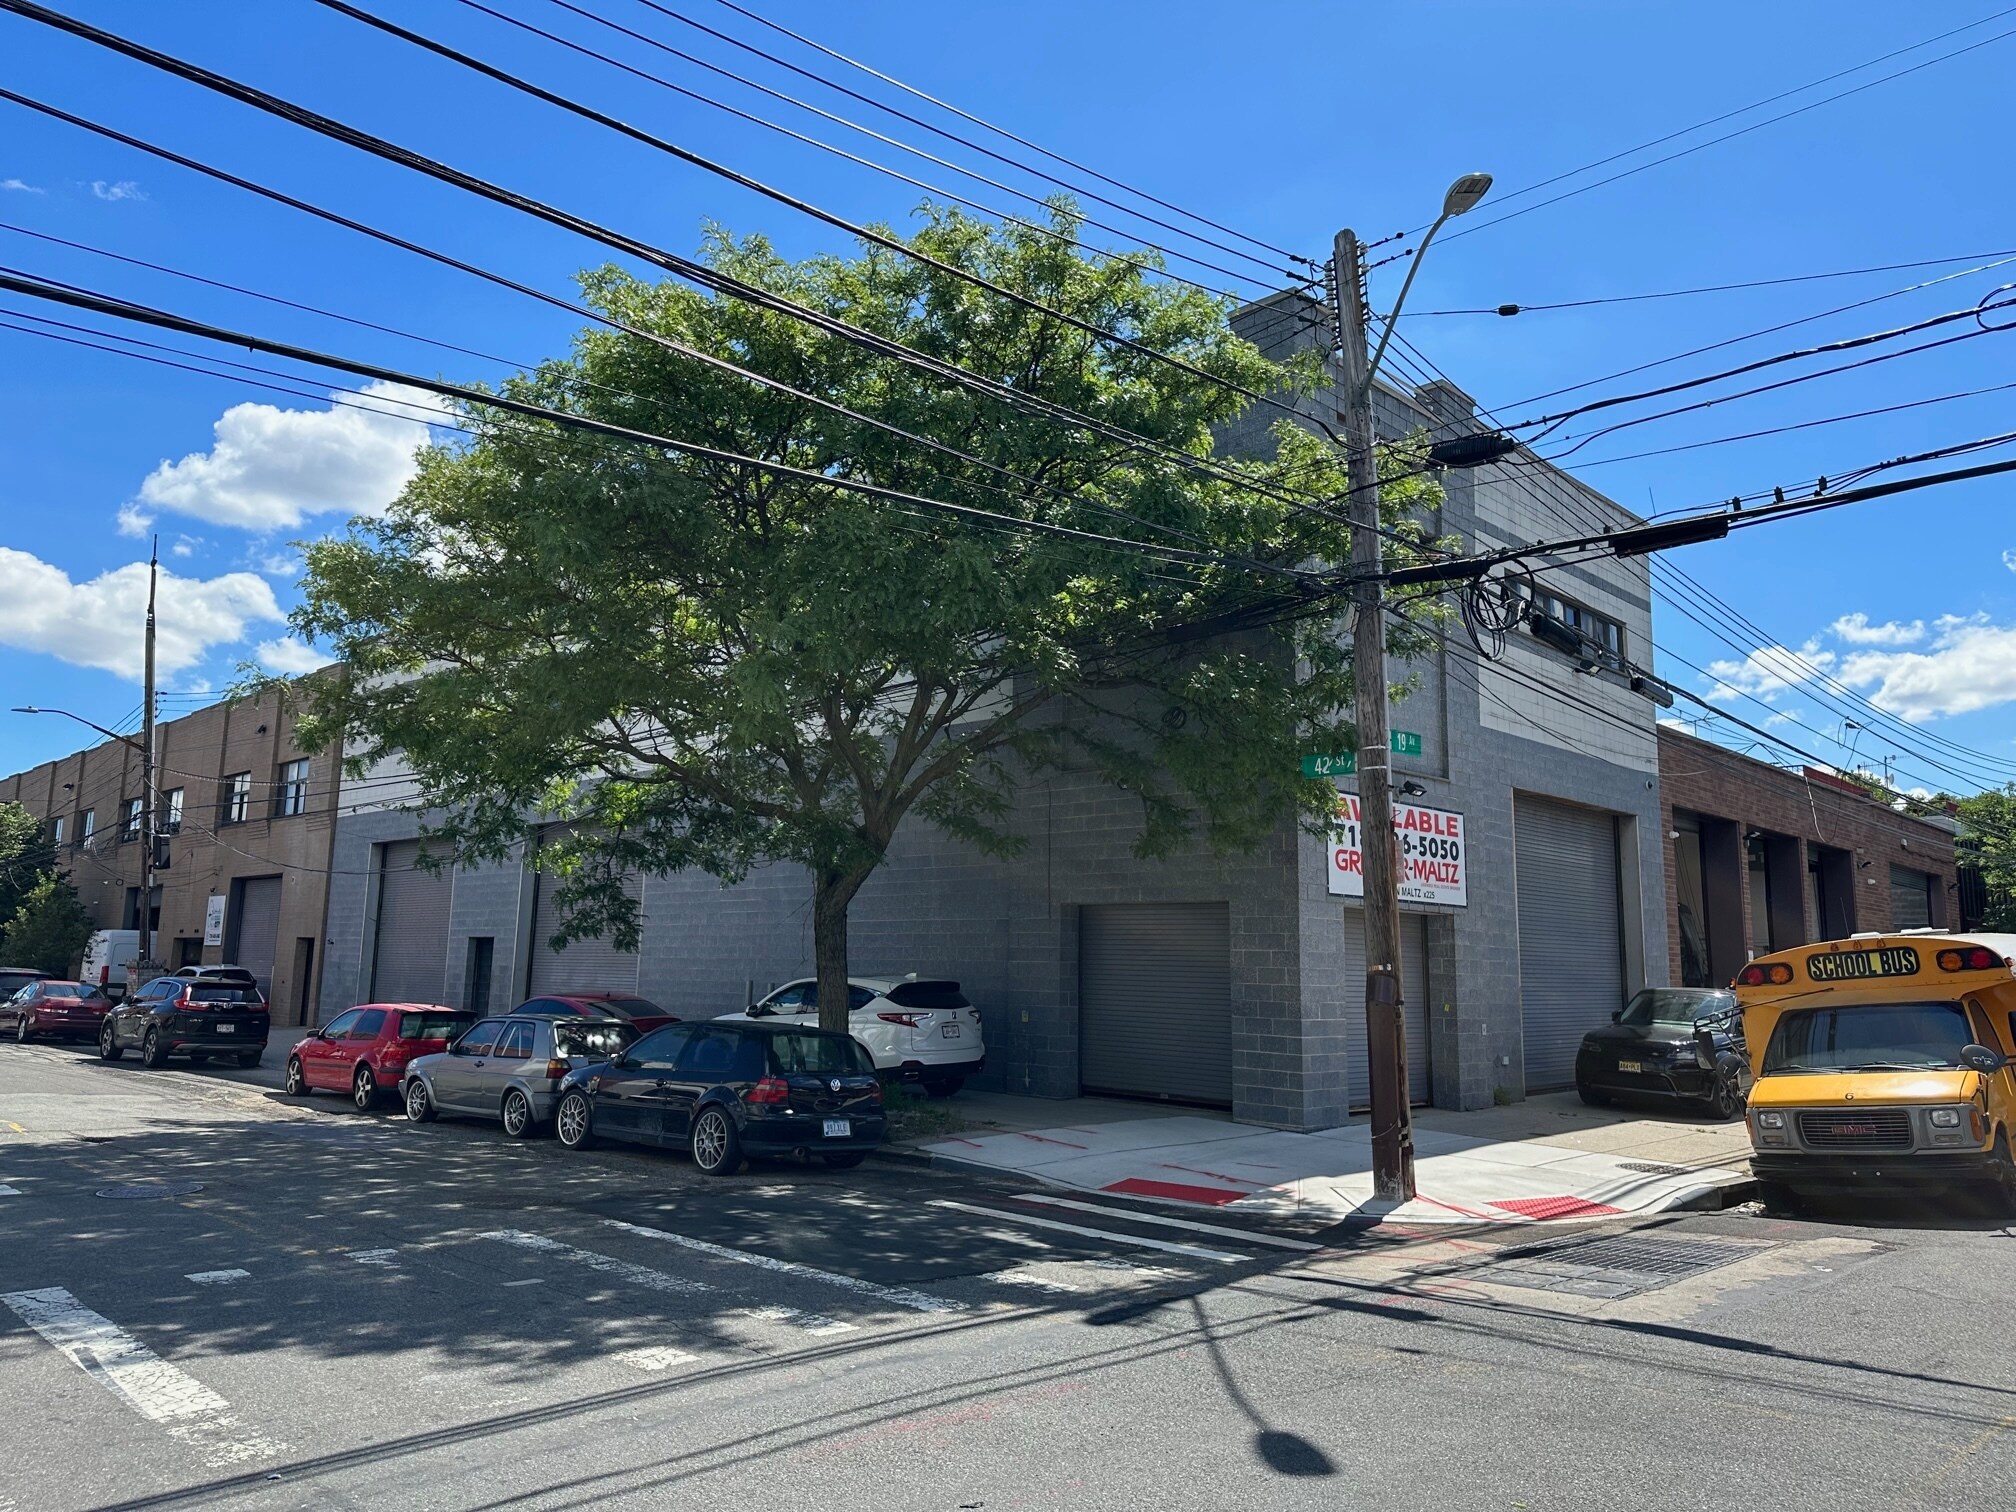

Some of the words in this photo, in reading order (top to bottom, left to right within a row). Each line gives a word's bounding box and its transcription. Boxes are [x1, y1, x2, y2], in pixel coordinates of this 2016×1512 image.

[1397, 733, 1406, 751] 19
[1408, 736, 1416, 746] Av
[1314, 757, 1330, 775] 42
[1336, 754, 1345, 767] St
[1401, 887, 1421, 898] MALTZ
[1423, 890, 1436, 900] x225
[1810, 953, 1877, 979] SCHOOL
[1880, 950, 1917, 975] BUS
